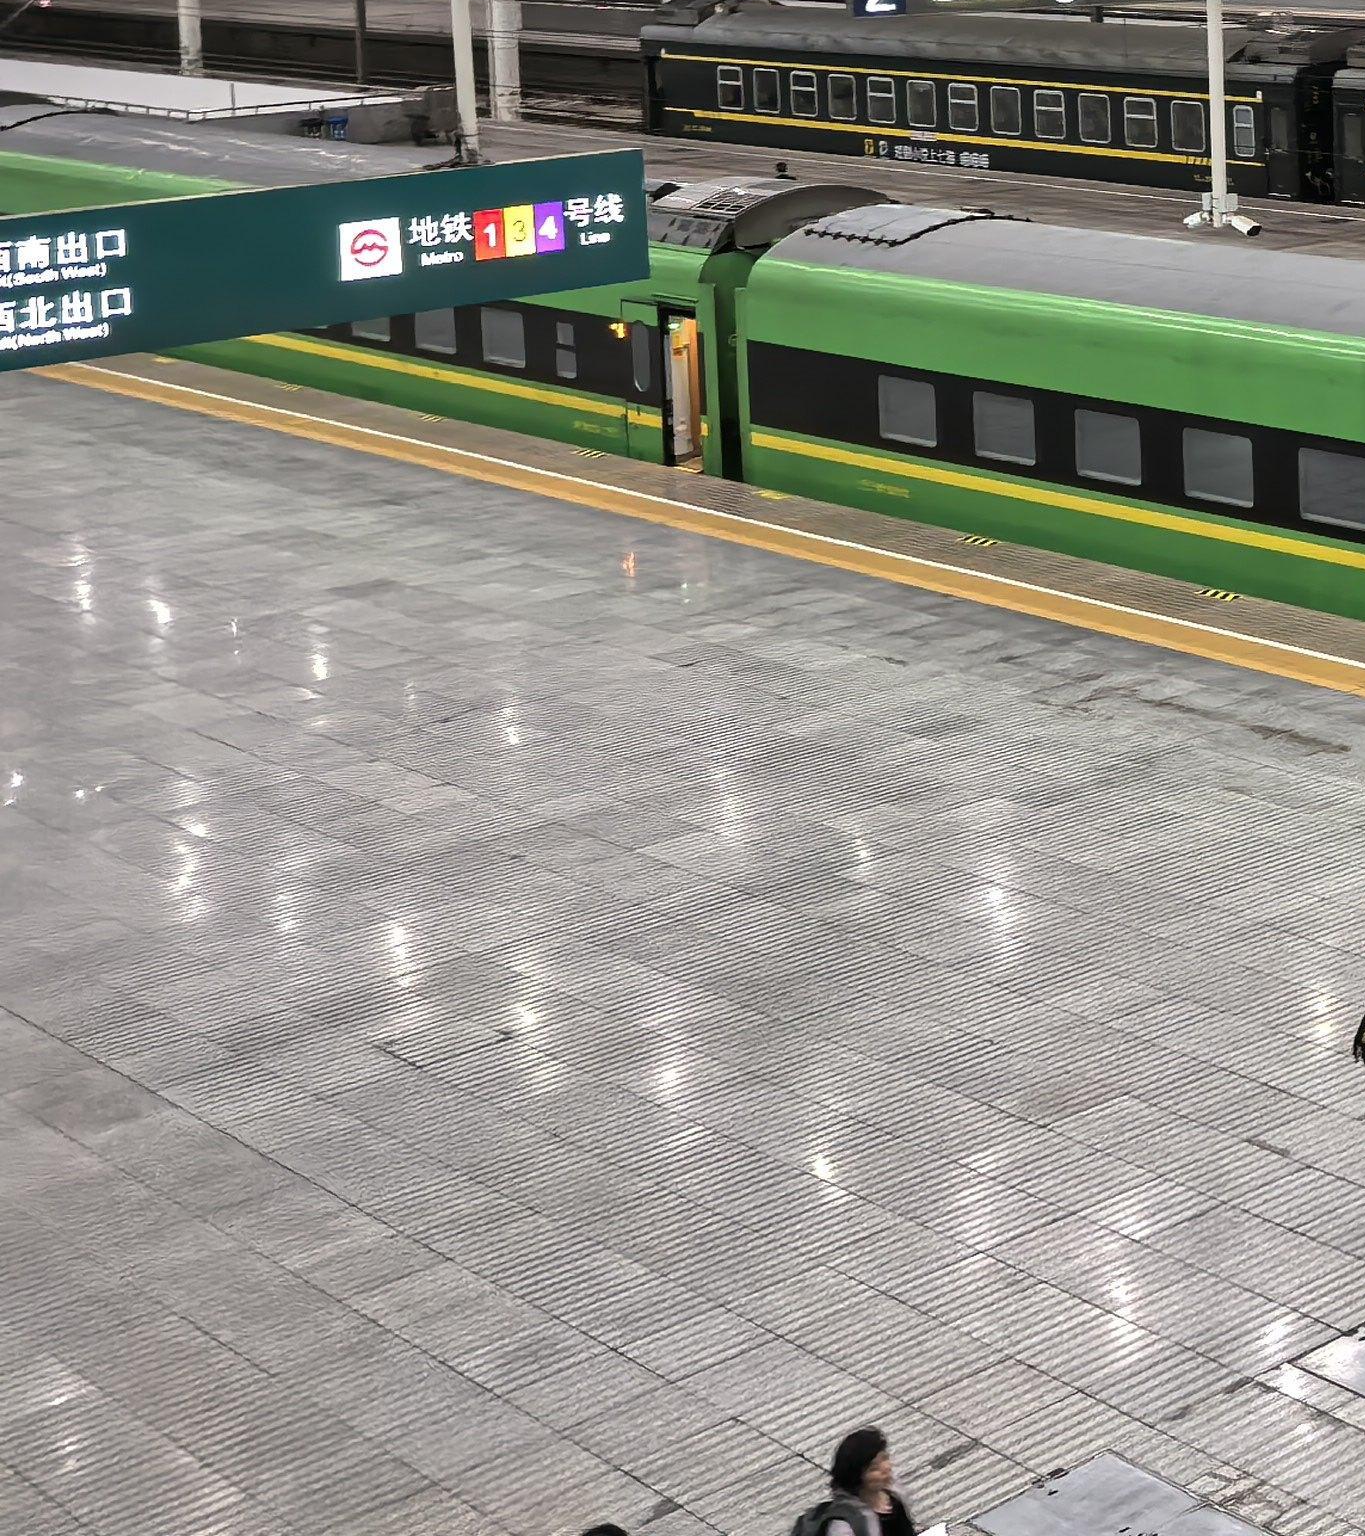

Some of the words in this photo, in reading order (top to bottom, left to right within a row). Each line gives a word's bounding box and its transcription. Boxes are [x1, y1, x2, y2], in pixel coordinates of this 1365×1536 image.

[408, 211, 474, 247] 地铁
[484, 223, 497, 248] 1
[512, 220, 527, 242] 3
[539, 215, 558, 241] 4
[563, 193, 625, 228] 号线
[421, 250, 464, 267] Metro
[580, 231, 611, 246] Line
